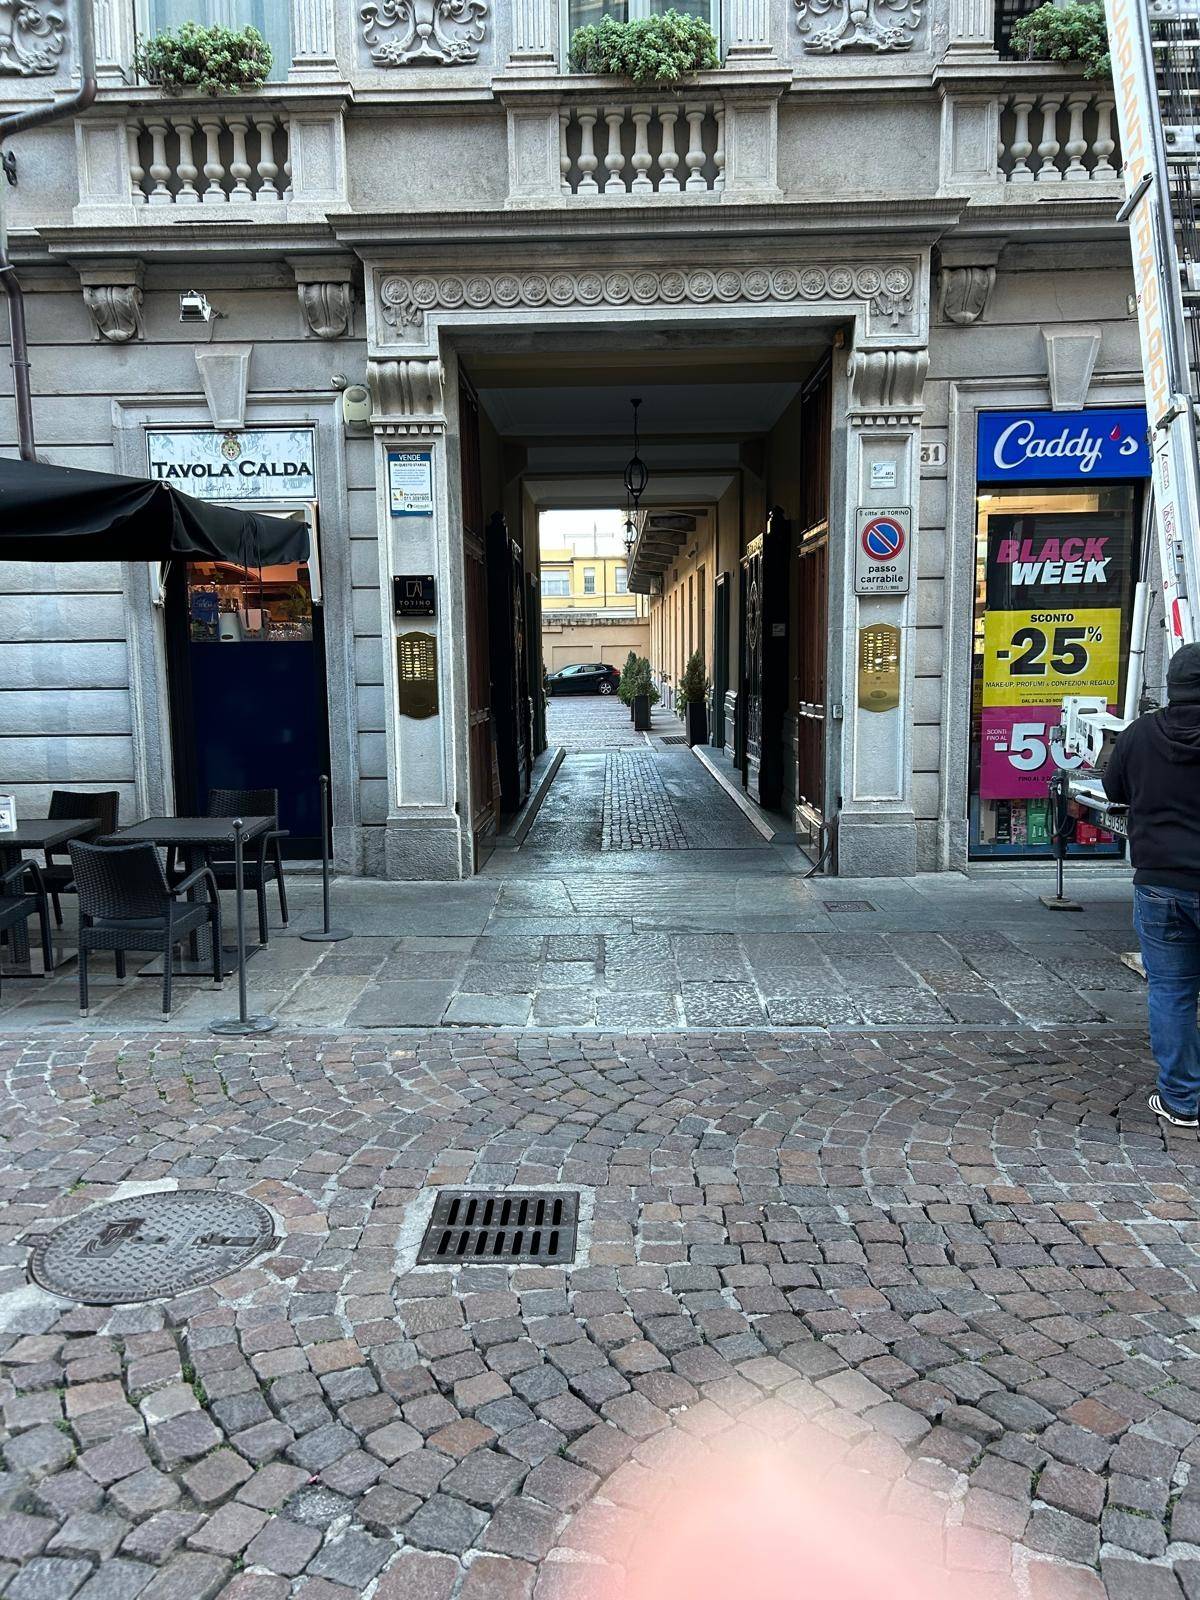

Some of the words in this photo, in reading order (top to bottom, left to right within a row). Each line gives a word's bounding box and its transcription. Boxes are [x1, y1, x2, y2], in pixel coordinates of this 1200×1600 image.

[921, 446, 940, 462] 31
[152, 461, 235, 479] TAVOLA
[239, 460, 312, 477] CALDA
[996, 537, 1110, 564] BLACK
[868, 565, 897, 573] passo
[1011, 557, 1113, 586] WEEK
[860, 574, 904, 583] carrabile
[1030, 613, 1075, 623] SCONTO
[1051, 679, 1089, 687] CONFEZIONI
